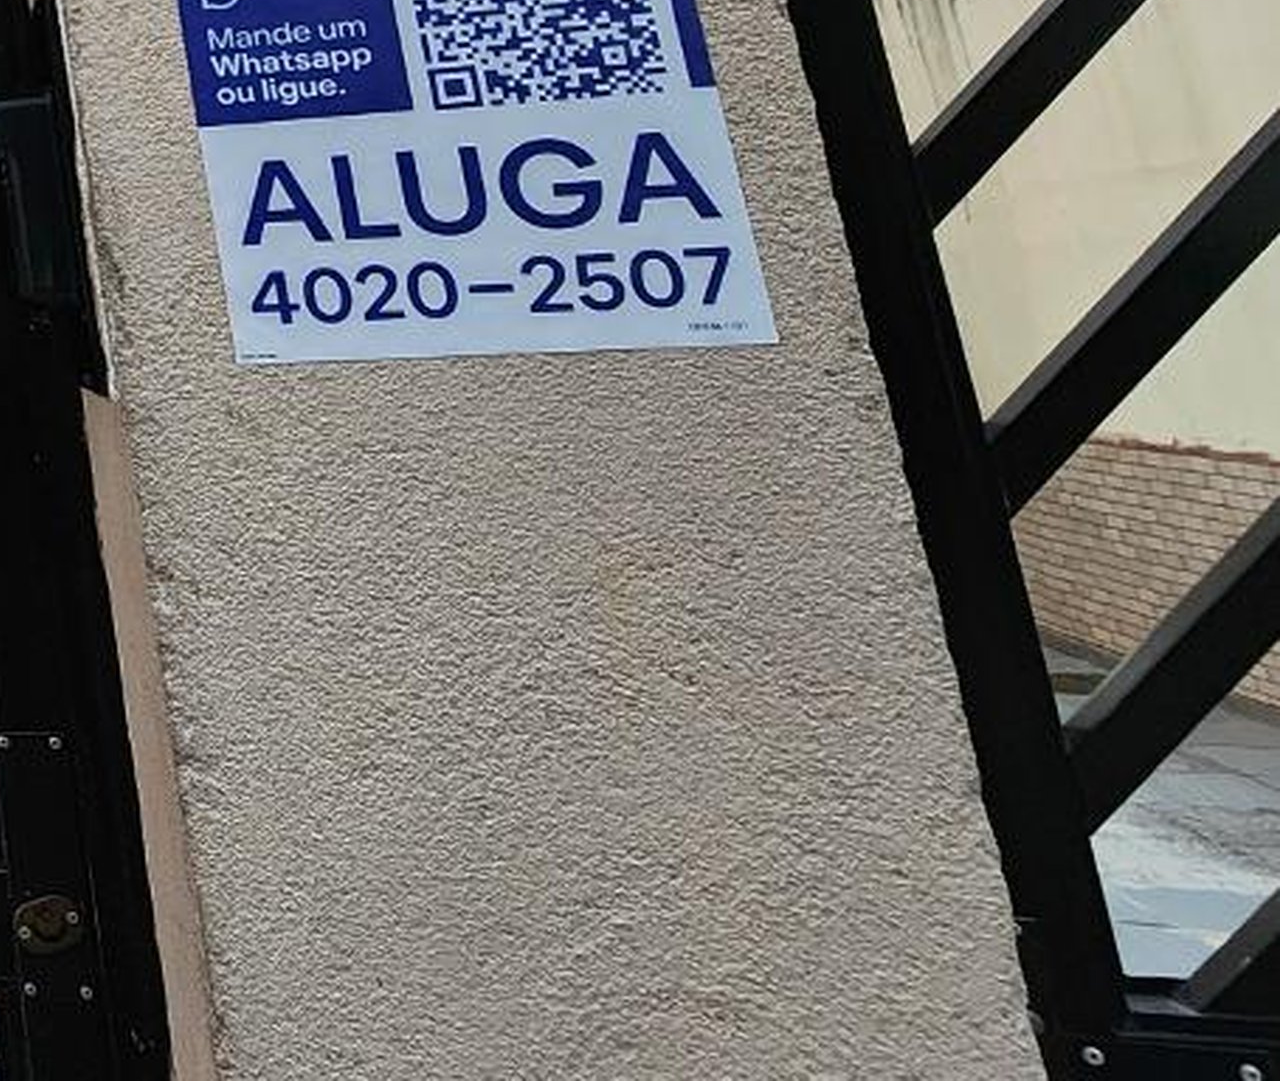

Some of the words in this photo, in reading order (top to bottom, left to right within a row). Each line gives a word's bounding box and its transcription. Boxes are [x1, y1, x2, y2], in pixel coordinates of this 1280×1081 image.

[207, 22, 312, 51] Mande
[318, 19, 367, 41] um
[209, 47, 372, 78] Whatsapp
[216, 86, 256, 105] ou
[260, 78, 347, 106] ligue.
[242, 131, 724, 246] ALUGA
[251, 246, 732, 325] 4020-2507
